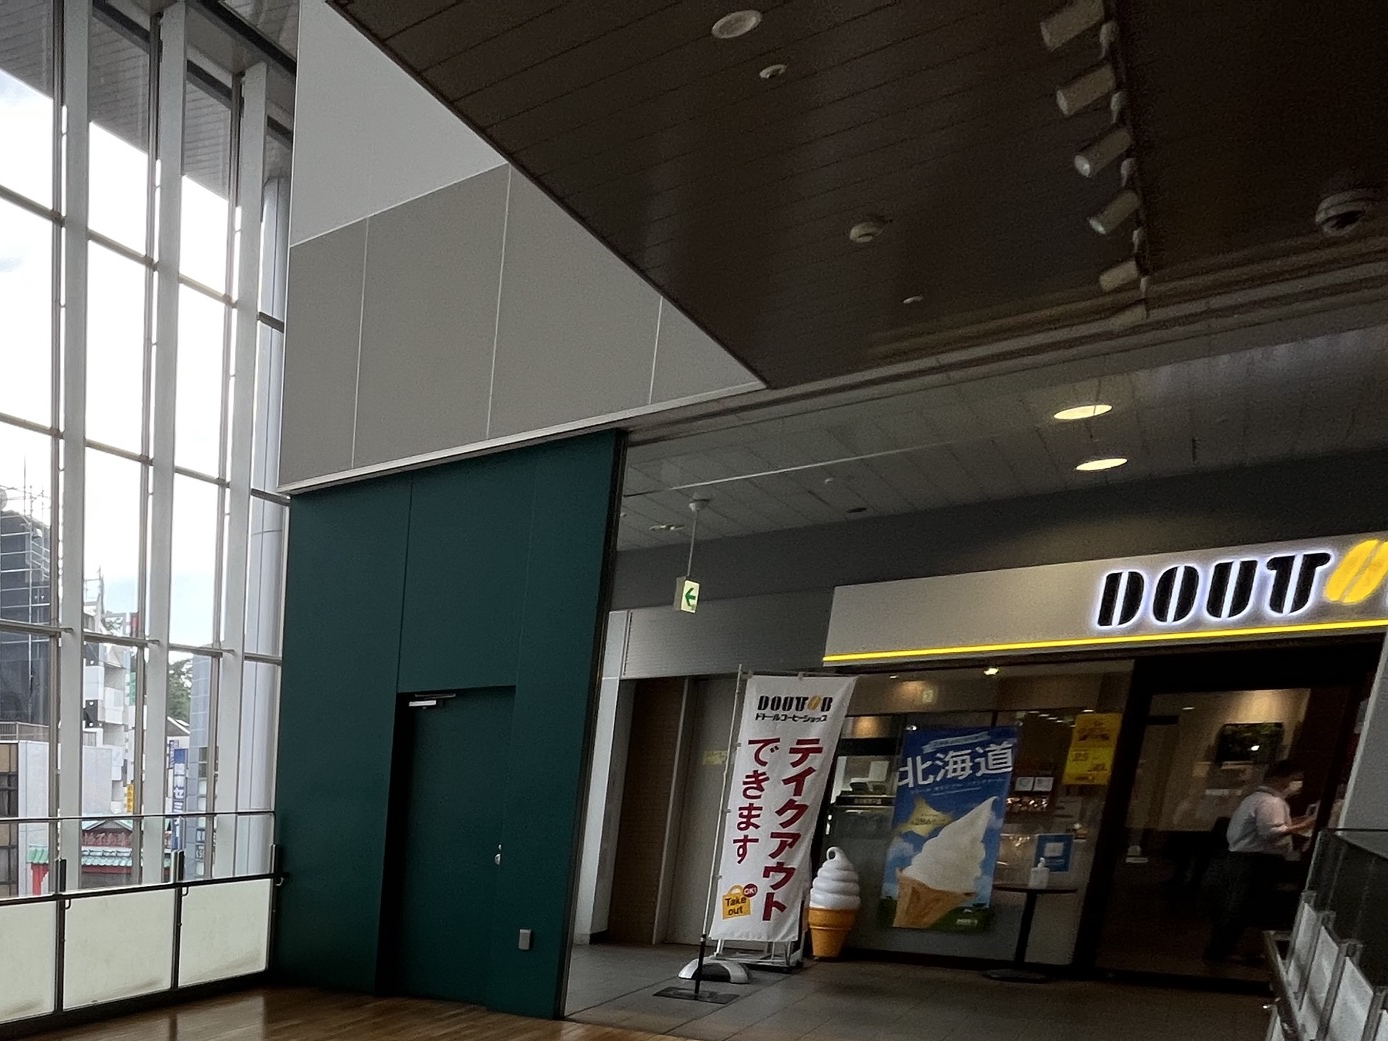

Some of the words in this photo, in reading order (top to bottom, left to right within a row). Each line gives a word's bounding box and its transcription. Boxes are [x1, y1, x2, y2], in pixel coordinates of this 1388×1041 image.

[757, 695, 834, 712] DOUTOR
[897, 741, 1014, 788] 北海道
[733, 737, 781, 865] できます
[762, 738, 824, 922] テイクアウト
[725, 896, 748, 908] Take
[729, 906, 744, 918] out
